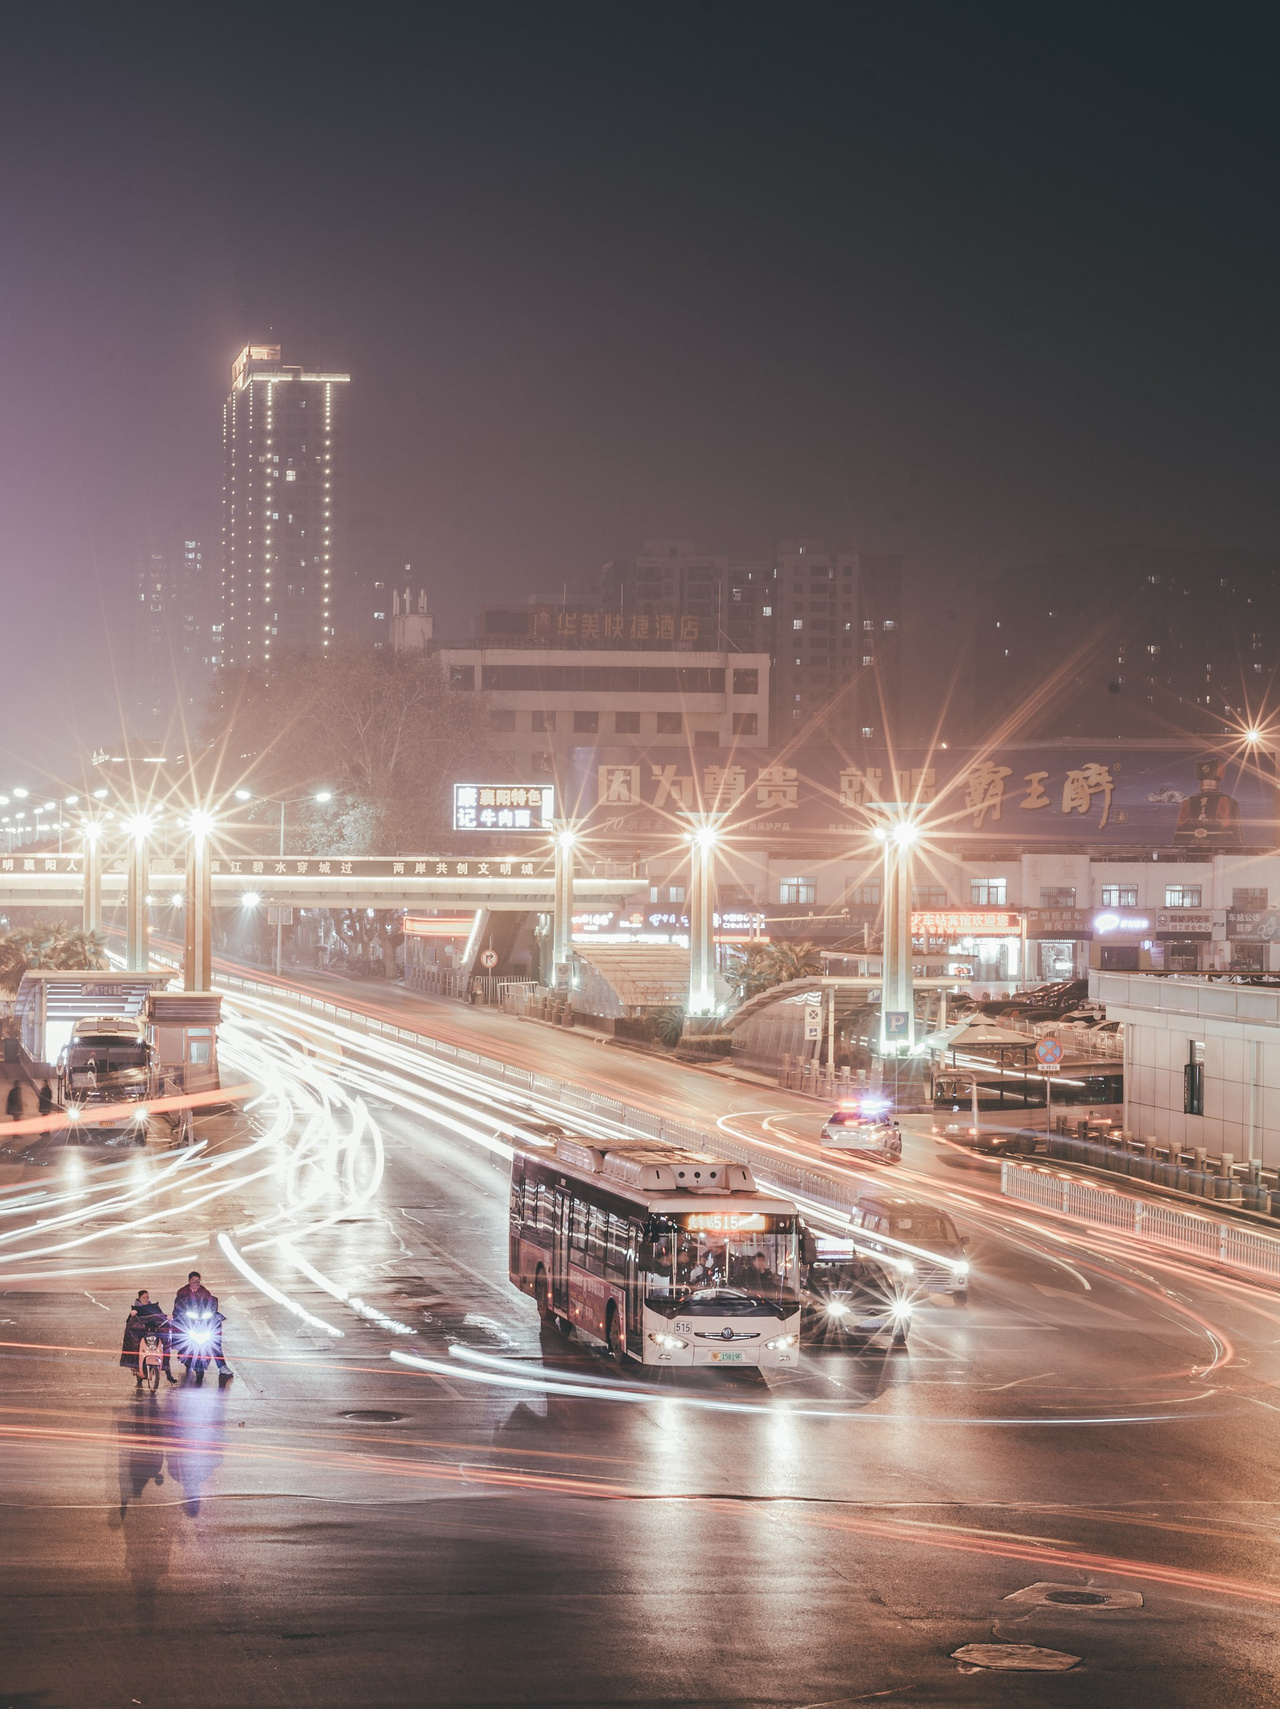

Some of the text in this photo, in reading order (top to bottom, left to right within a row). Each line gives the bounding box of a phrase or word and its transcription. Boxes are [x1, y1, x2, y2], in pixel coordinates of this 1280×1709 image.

[556, 612, 700, 641] 华美快捷酒店
[479, 788, 542, 807] 襄阳特色
[597, 764, 800, 809] 因为尊贵
[954, 760, 1115, 830] 霸王醉
[480, 809, 531, 828] 牛肉面
[211, 861, 353, 874] 襄江碧水穿城过
[393, 862, 534, 875] 两岸共创文明城
[911, 914, 1009, 927] 火车站宾馆欢迎您
[1228, 913, 1261, 922] 车站公话
[1236, 923, 1253, 932] 超市
[675, 1322, 691, 1332] 515
